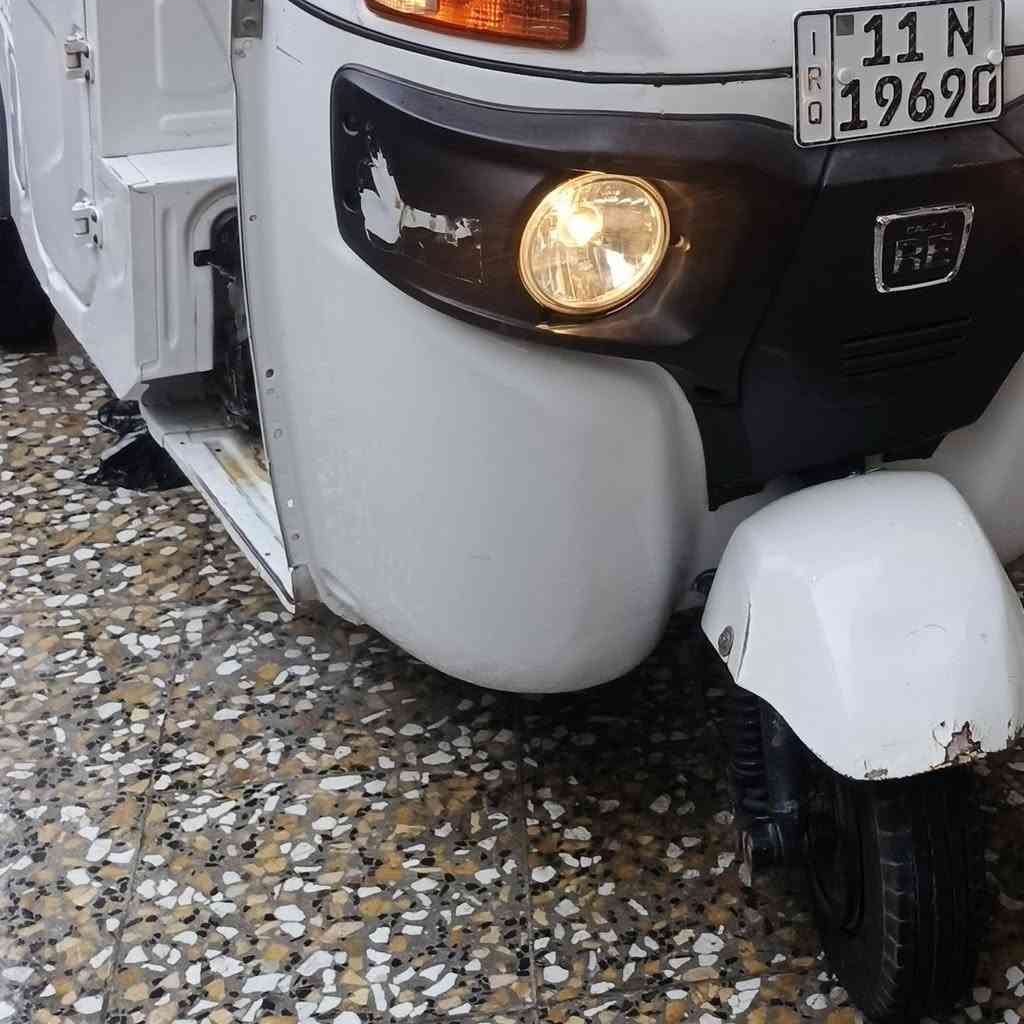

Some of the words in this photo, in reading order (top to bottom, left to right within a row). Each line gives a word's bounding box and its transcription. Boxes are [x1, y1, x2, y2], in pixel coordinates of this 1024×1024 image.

[862, 11, 924, 67] 11
[947, 5, 975, 58] N
[839, 64, 998, 132] 19690
